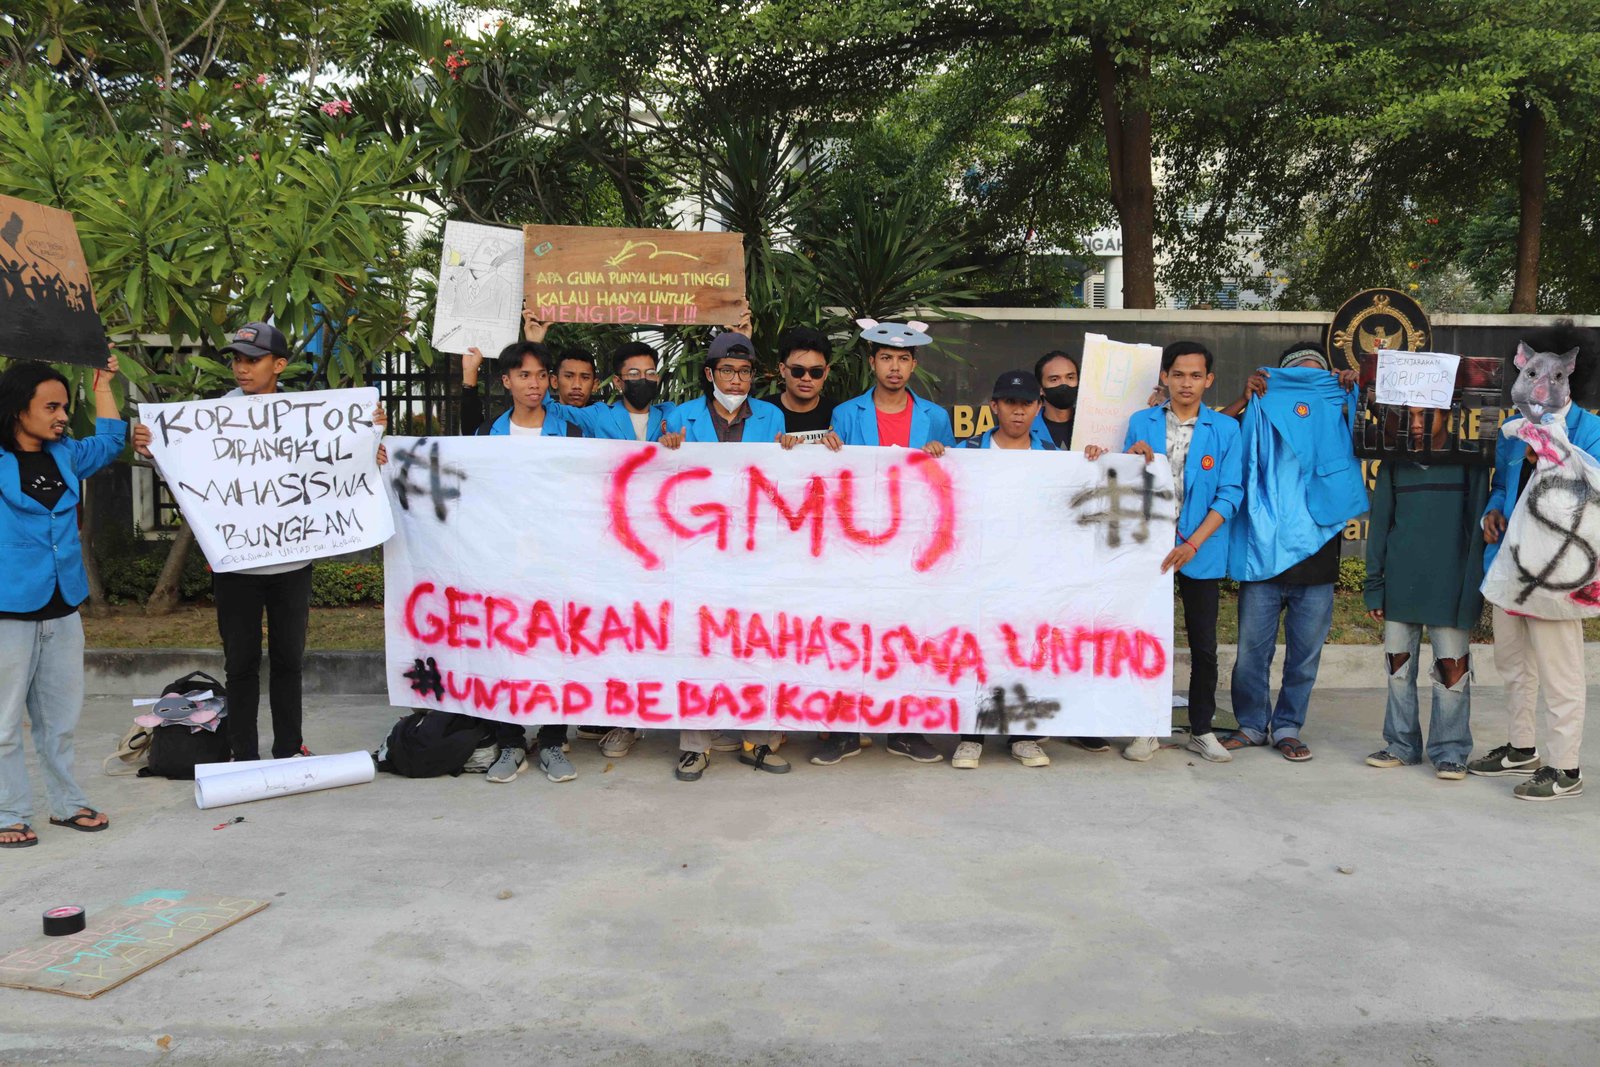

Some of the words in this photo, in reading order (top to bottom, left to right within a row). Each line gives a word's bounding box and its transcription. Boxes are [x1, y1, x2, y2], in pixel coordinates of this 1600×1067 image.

[536, 271, 563, 285] APA
[567, 271, 605, 285] GUNA
[608, 271, 648, 285] PUNYA
[649, 272, 678, 285] ILMU
[681, 272, 730, 287] TINGGI
[536, 291, 589, 307] KALAU
[597, 291, 647, 306] HANYA
[649, 291, 696, 306] UNTUK
[1382, 370, 1452, 387] KORUPTOR
[155, 399, 373, 448] KORUPTOR
[212, 435, 352, 465] DIRANGKUL
[178, 471, 374, 507] MAHASISWA
[215, 508, 364, 549] BUNGKAM
[404, 582, 671, 656] GERAKAN
[698, 605, 987, 686] MAHASISWA
[1000, 623, 1167, 679] UNTAD
